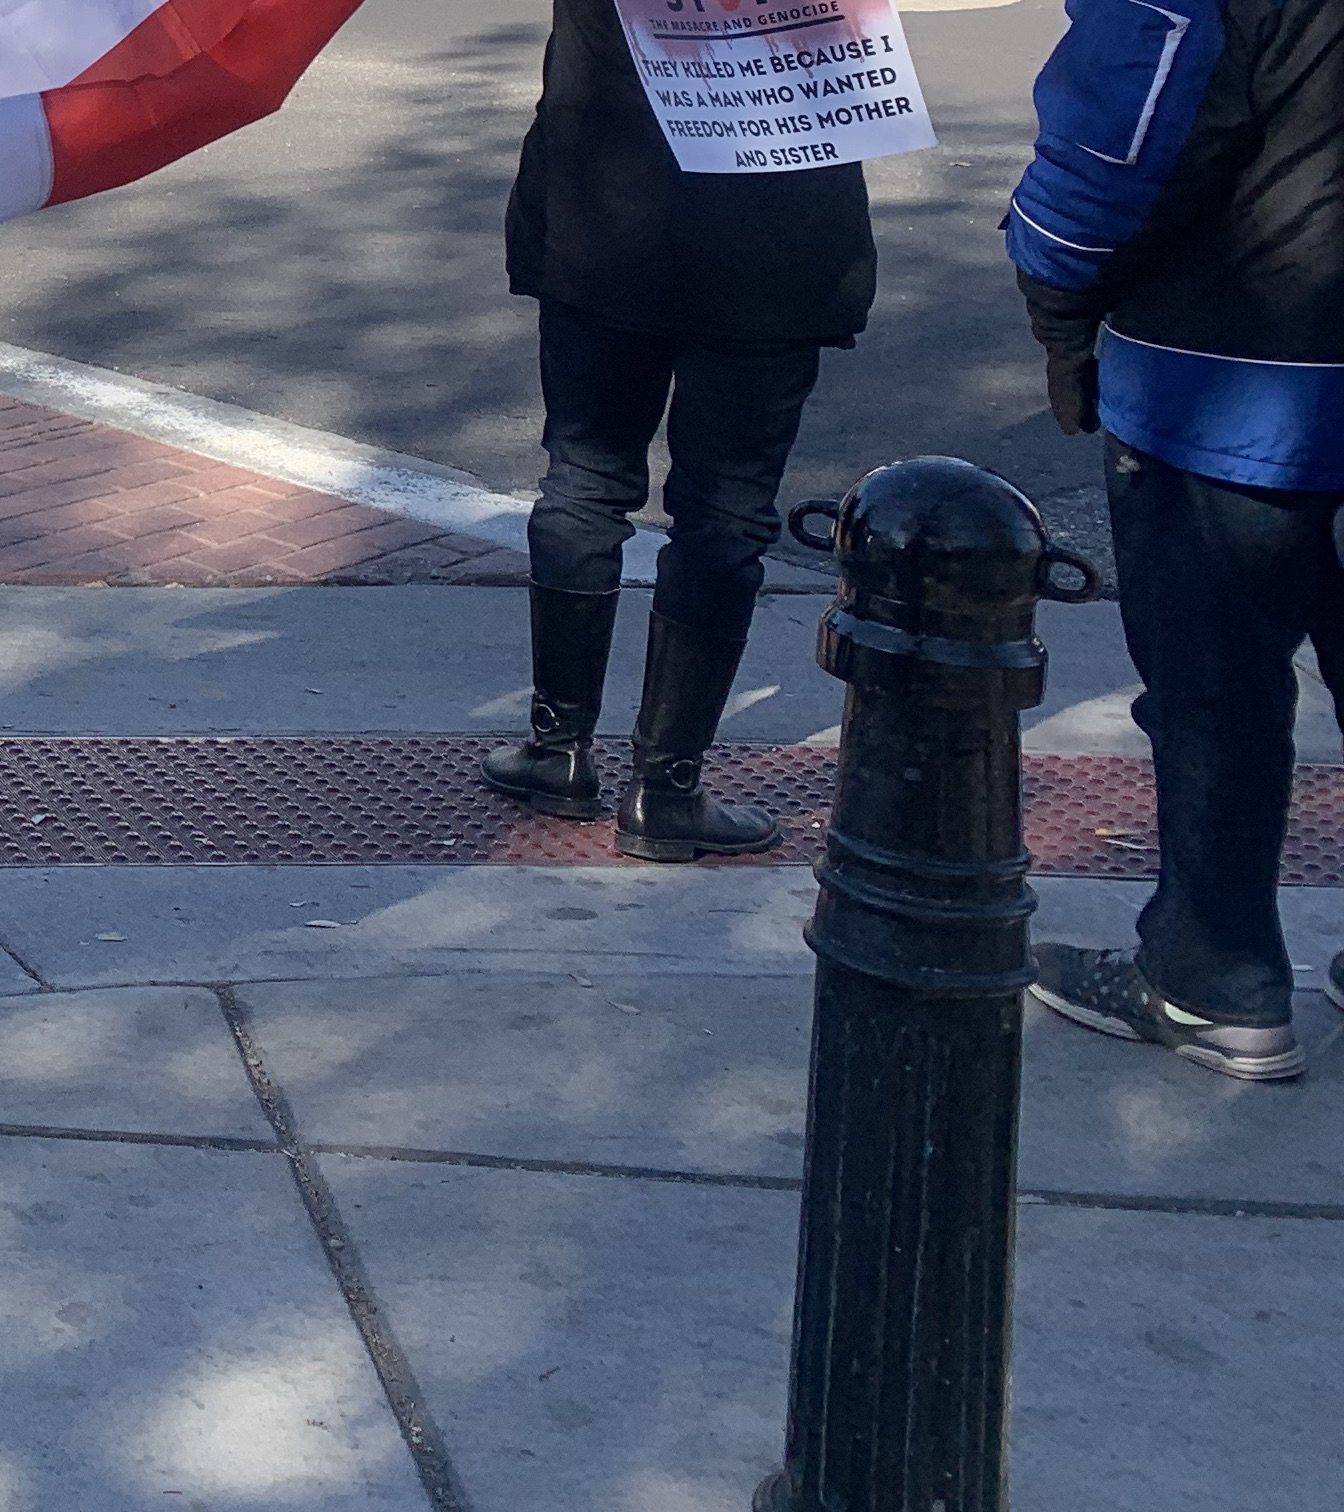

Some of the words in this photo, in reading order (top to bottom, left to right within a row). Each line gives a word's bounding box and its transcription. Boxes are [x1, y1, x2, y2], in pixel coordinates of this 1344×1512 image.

[649, 18, 669, 31] THE
[723, 17, 752, 32] AND
[758, 0, 840, 26] GENOCIDE
[642, 59, 679, 80] THEY
[682, 59, 736, 80] KILLED
[737, 57, 767, 77] ME
[769, 38, 876, 74] BECAUSE
[881, 35, 894, 53] I
[656, 89, 694, 108] WAS
[697, 90, 709, 108] A
[712, 89, 746, 108] MAN
[746, 85, 794, 106] WHO
[797, 67, 897, 100] WANTED
[666, 119, 737, 138] FREEDOM
[738, 118, 773, 137] FOR
[775, 114, 812, 135] HIS
[816, 96, 913, 129] MOTHER
[735, 149, 767, 168] AND
[770, 142, 838, 166] SISTER
